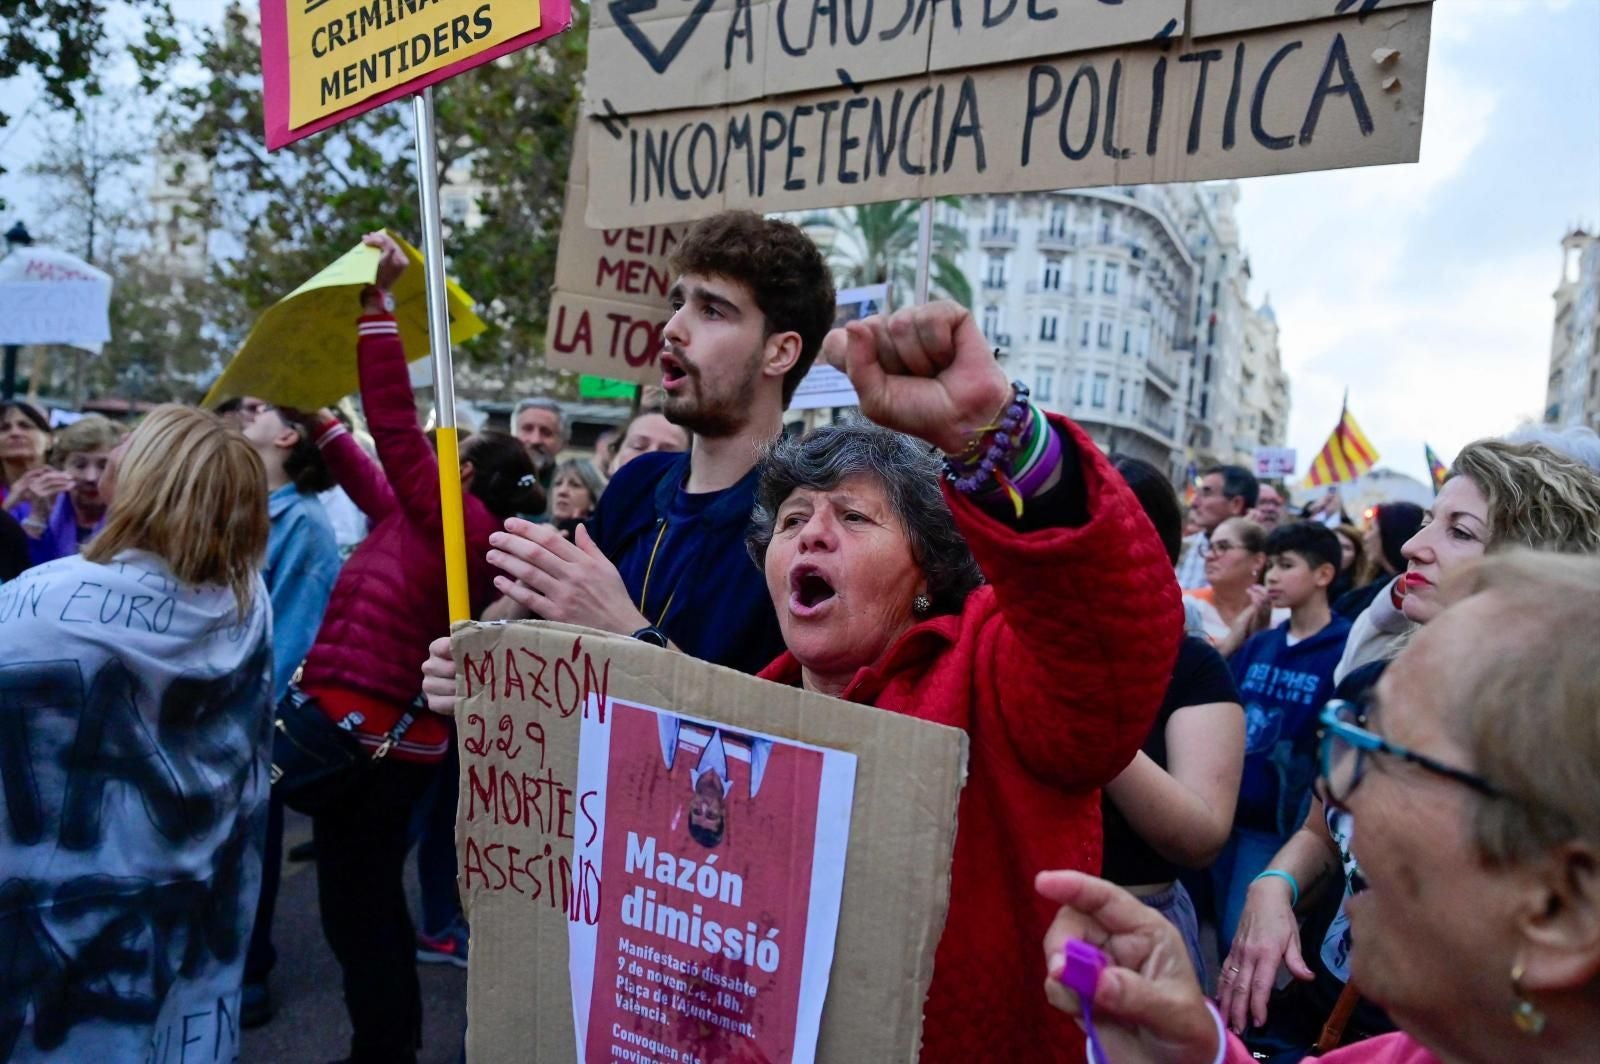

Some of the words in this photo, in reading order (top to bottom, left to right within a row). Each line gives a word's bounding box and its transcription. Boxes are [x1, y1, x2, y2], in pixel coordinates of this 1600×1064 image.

[320, 4, 493, 106] MENTIDERS
[724, 0, 754, 71] A
[553, 305, 592, 356] LA
[60, 581, 177, 634] EURO
[463, 636, 611, 724] MAZÓN
[464, 714, 546, 769] 229
[467, 765, 598, 848] MORTES
[624, 831, 744, 907] Mazón
[621, 886, 780, 973] dimissió
[618, 937, 698, 977] Manifestació
[702, 967, 757, 997] dissabte
[618, 956, 626, 970] 9
[629, 961, 643, 977] de
[647, 969, 712, 1002] noveme.
[716, 992, 743, 1014] 18h.
[615, 993, 670, 1025] València.
[616, 975, 650, 999] Plaça
[653, 989, 668, 1005] de
[672, 995, 756, 1038] l'Ajuntament.
[612, 1023, 679, 1061] Convoquen
